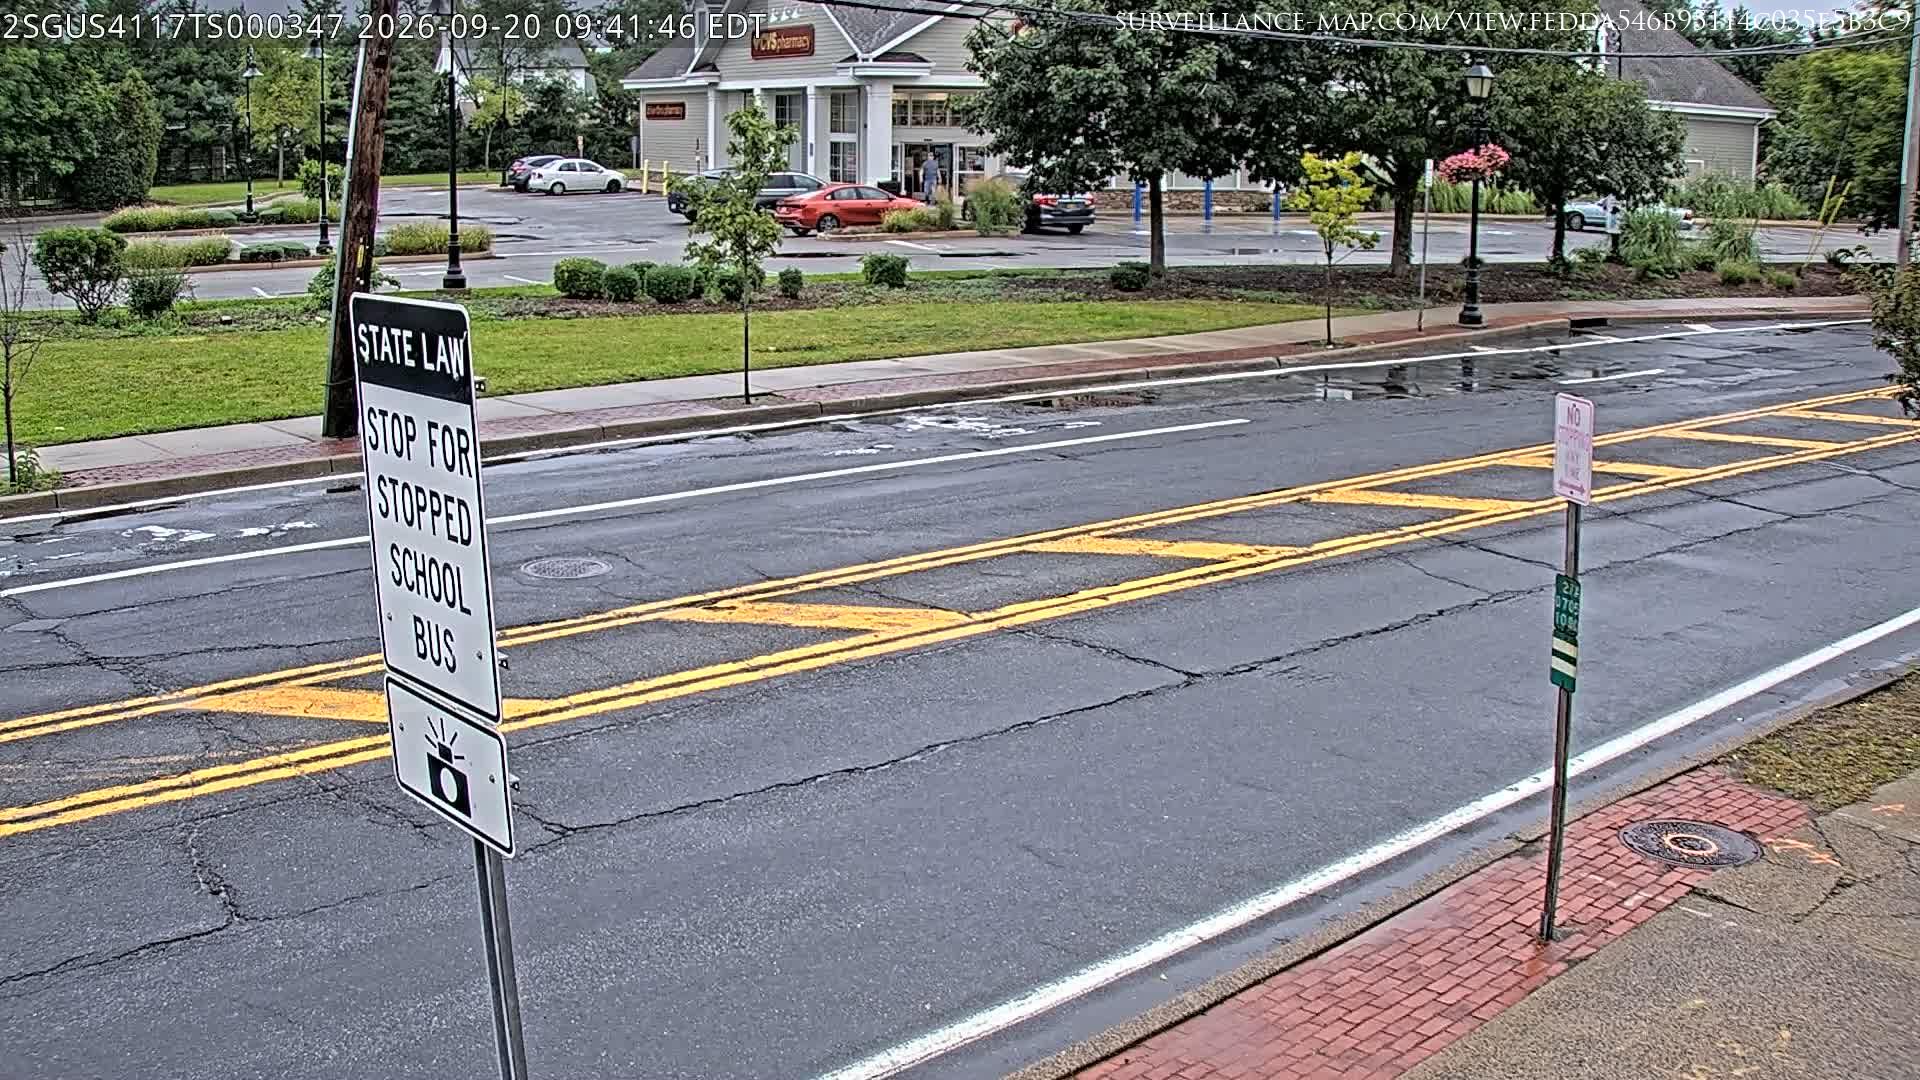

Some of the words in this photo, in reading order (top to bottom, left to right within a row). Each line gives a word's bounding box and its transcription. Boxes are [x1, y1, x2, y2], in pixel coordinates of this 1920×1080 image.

[358, 323, 416, 367] STATE
[421, 330, 468, 382] LAW
[367, 406, 417, 461] STOP
[427, 420, 473, 478] FOR
[1567, 406, 1581, 427] NO
[377, 474, 472, 547] STOPPED
[390, 543, 472, 616] SCHOOL
[413, 614, 457, 674] BUS
